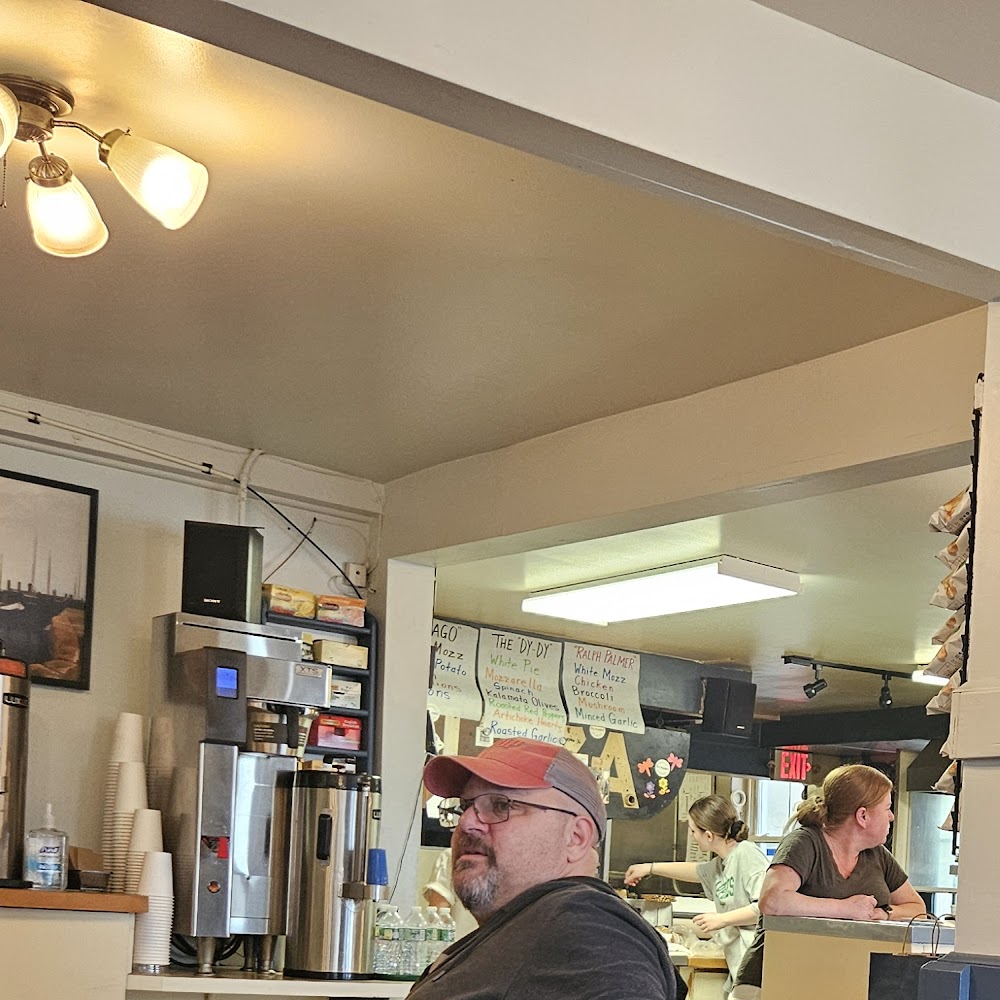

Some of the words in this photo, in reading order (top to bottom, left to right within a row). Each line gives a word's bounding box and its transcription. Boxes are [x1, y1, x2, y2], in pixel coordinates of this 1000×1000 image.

[431, 624, 462, 642] AGO"
[491, 633, 514, 651] THE
[518, 637, 553, 659] "DY-DY"
[434, 658, 466, 676] Potato
[490, 654, 517, 669] White
[523, 659, 540, 676] Pie
[574, 645, 602, 663] "RALPH
[604, 649, 637, 670] PALMER"
[485, 667, 543, 692] Mozzarella
[574, 662, 598, 677] White
[602, 668, 626, 684] Mozz
[574, 675, 614, 692] Chicken
[485, 688, 528, 704] Kalamata
[532, 696, 560, 711] Olives
[494, 682, 534, 696] Spinach
[572, 685, 614, 702] Broccoli
[488, 697, 520, 712] Roasted
[523, 704, 538, 715] Red
[578, 696, 625, 714] Mushroom
[493, 709, 533, 724] Artichoke
[575, 707, 606, 722] Minced
[608, 712, 638, 729] Garlic
[490, 720, 528, 738] Roasted
[531, 727, 559, 744] Garlic
[779, 751, 809, 781] EXIT
